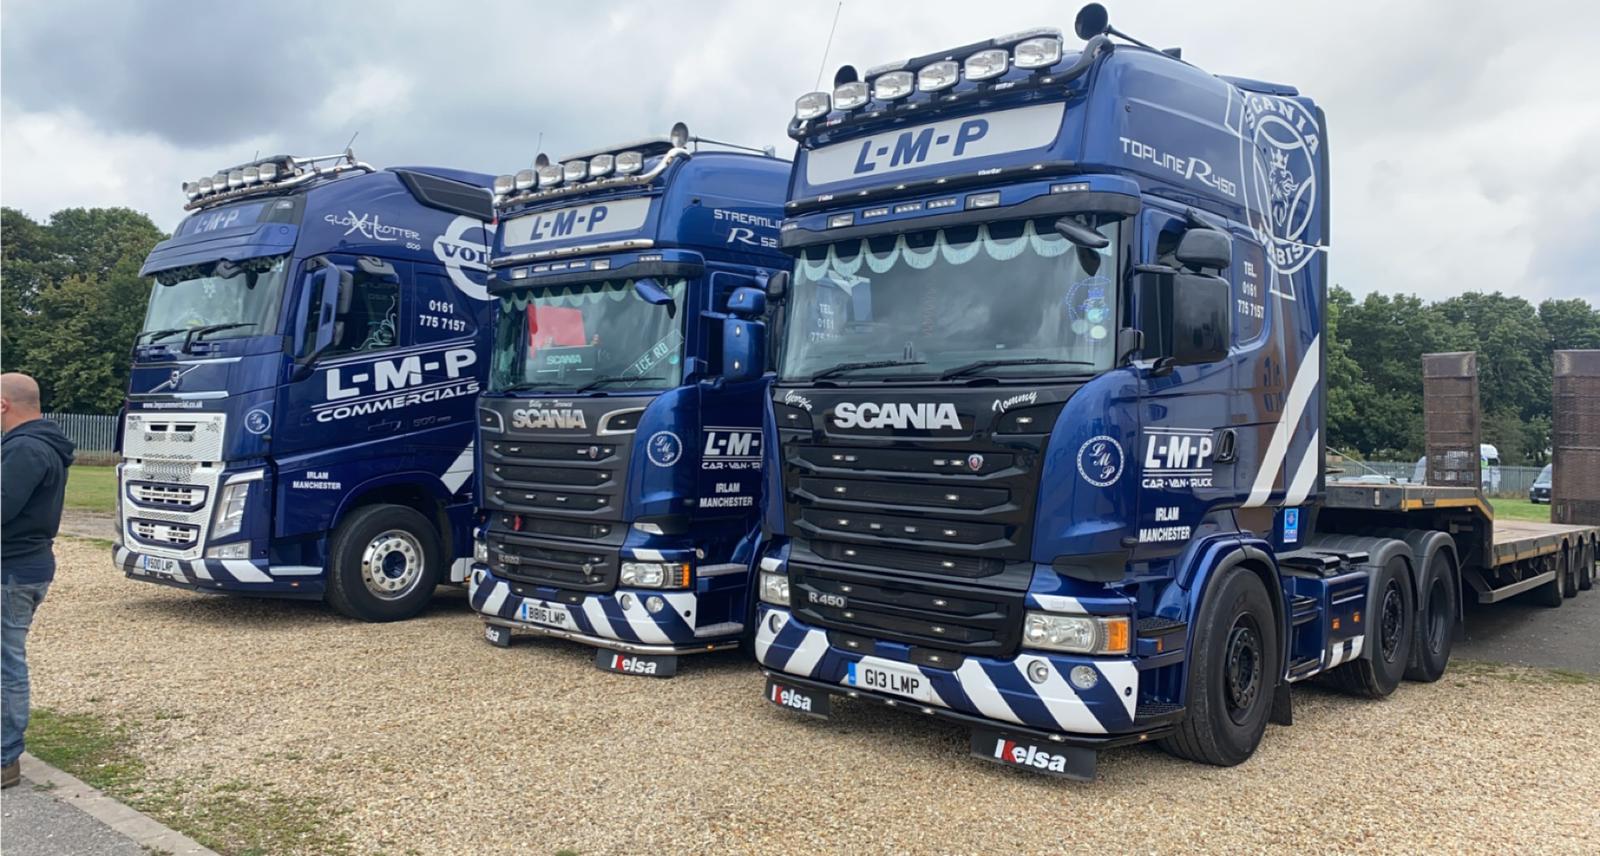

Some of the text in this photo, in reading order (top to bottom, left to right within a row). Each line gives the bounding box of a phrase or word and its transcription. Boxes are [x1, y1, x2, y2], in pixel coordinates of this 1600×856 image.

[1244, 96, 1320, 156] SCANIA
[853, 119, 989, 174] L-M-P
[1119, 136, 1237, 198] TOPLINE R 450
[530, 206, 608, 240] L-M-P
[713, 208, 783, 230] STREAMLI
[438, 241, 492, 265] VOL
[760, 236, 778, 249] 52
[1242, 281, 1257, 298] 0161
[429, 300, 454, 314] 0161
[1237, 299, 1264, 319] 775 7157
[419, 315, 466, 332] 775 7157
[546, 354, 582, 366] SCANIA
[326, 348, 477, 401] L-M-P
[316, 382, 481, 423] COMMERCIALS
[512, 408, 588, 429] SCANIA
[834, 402, 963, 431] SCANIA
[703, 432, 762, 455] L-M-
[1145, 435, 1213, 468] L-M-P
[292, 480, 342, 490] MANCHESTER
[307, 471, 329, 480] IRLAM
[716, 483, 741, 493] IRLAM
[699, 496, 753, 508] MANCHESTER
[1155, 507, 1180, 522] IRLAM
[1139, 526, 1191, 543] MANCHESTER
[808, 591, 845, 608] R 450
[528, 606, 566, 625] BB16 LMP
[610, 653, 657, 675] Kelsa
[865, 669, 920, 694] G13 LMP
[771, 684, 812, 712] Kelsa
[993, 738, 1067, 773] Kelsa
